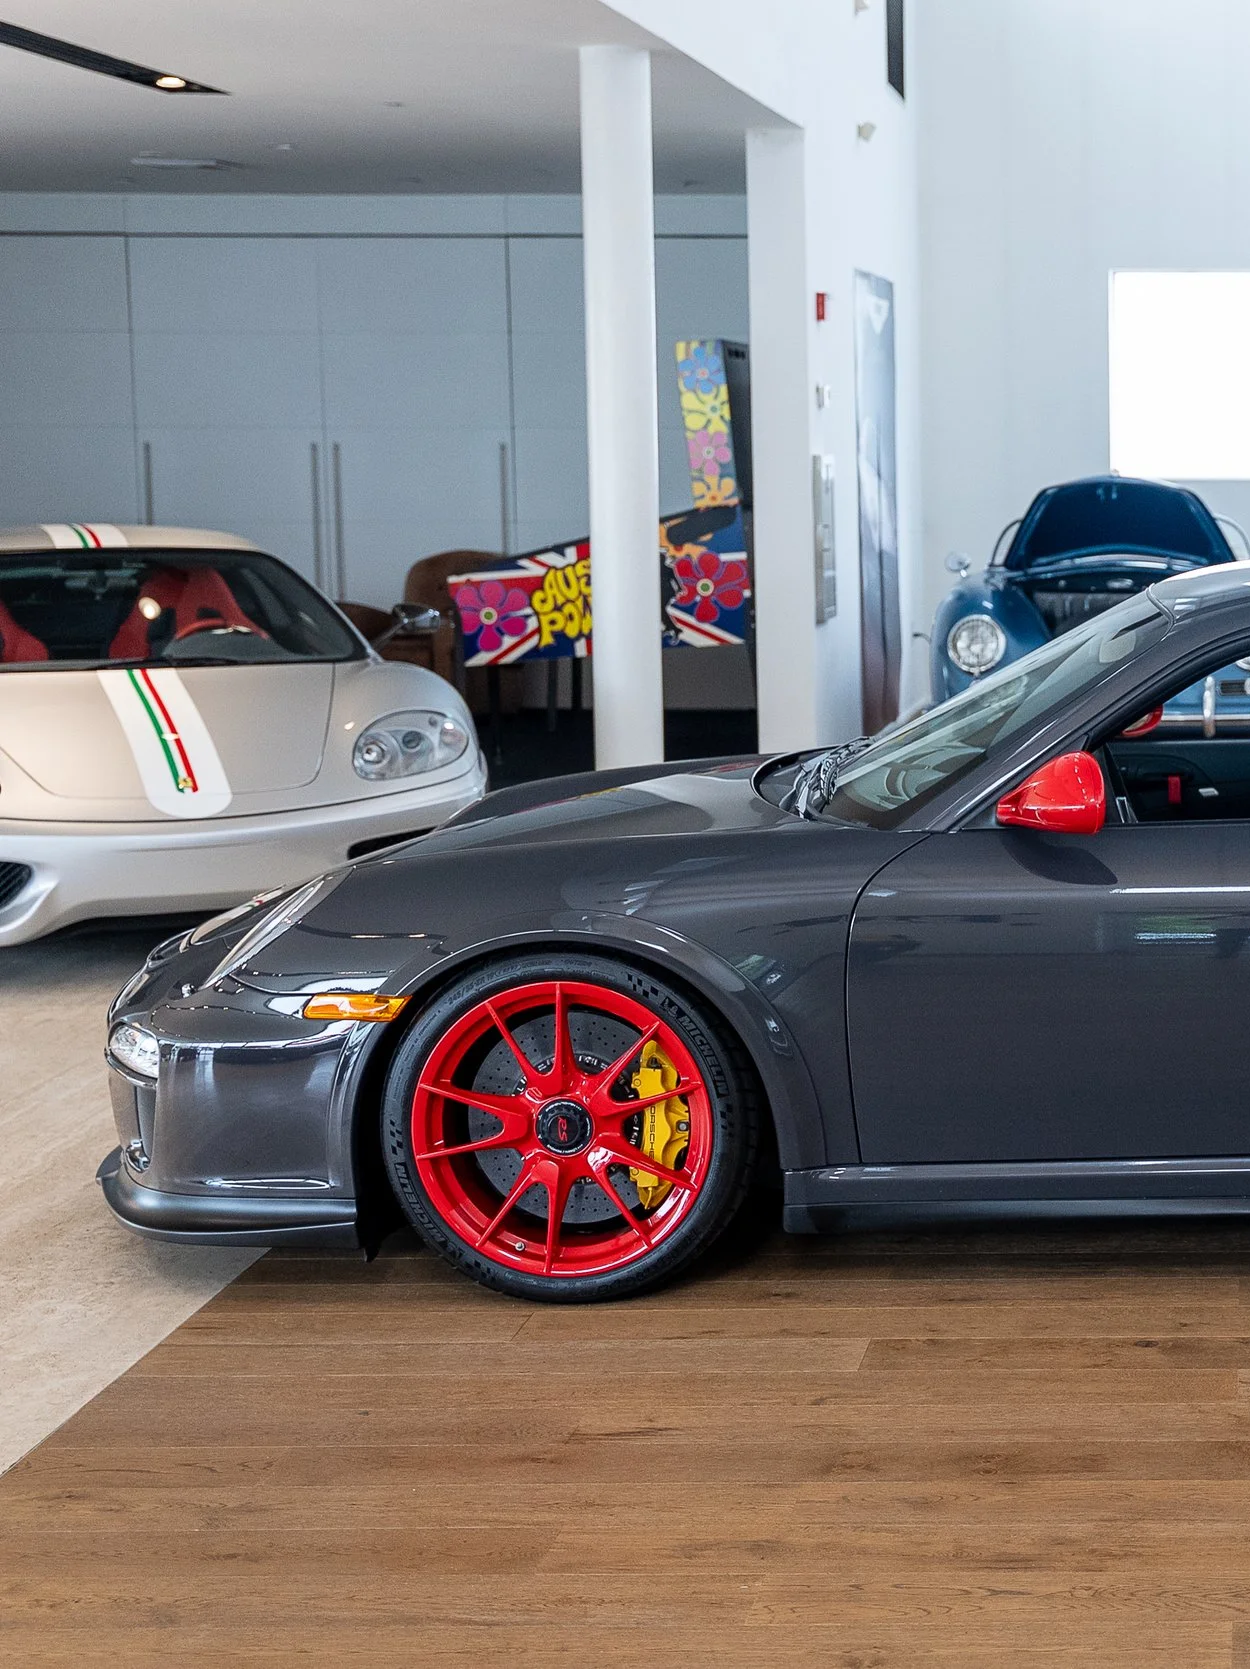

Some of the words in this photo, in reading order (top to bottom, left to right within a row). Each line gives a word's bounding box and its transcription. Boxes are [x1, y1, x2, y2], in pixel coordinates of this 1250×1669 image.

[679, 1015, 729, 1096] MICHELIN
[558, 1116, 568, 1142] RS
[395, 1162, 448, 1243] MICHELIN
